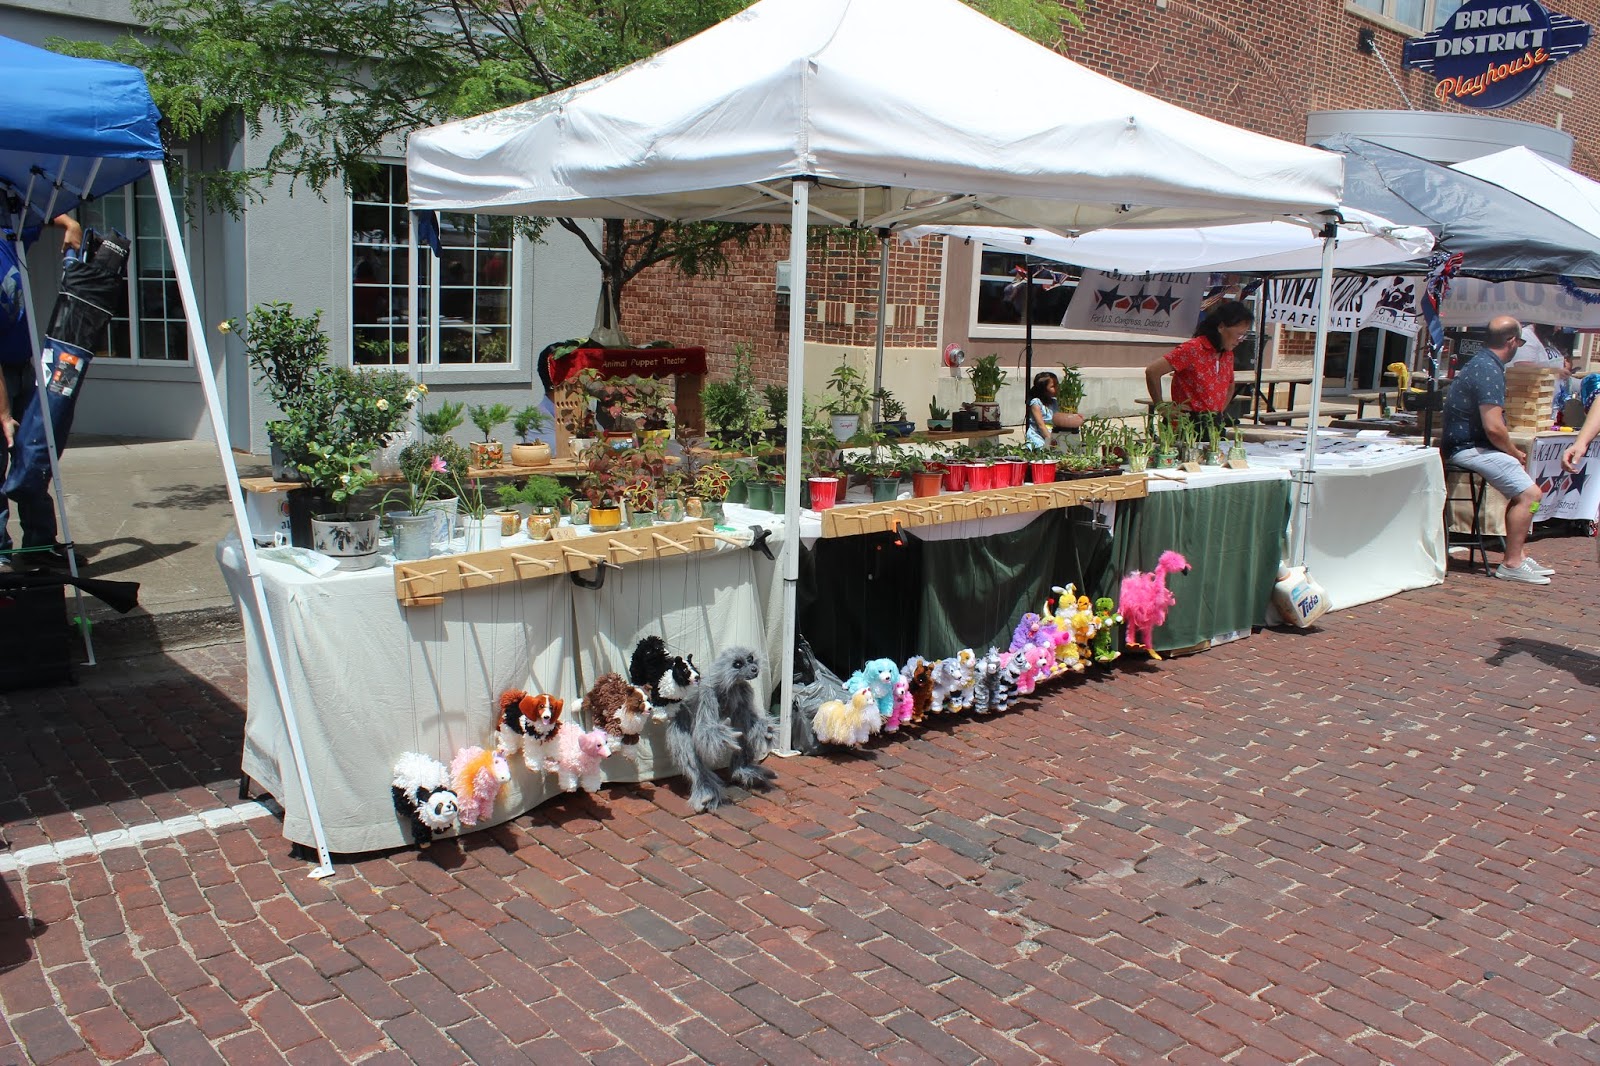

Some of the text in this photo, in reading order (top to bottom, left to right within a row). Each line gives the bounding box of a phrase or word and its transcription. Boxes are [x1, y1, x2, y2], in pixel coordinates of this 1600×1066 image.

[1455, 3, 1532, 30] BRICK
[1435, 28, 1548, 57] DISTRICT
[1434, 47, 1550, 104] Playhouse
[1090, 314, 1101, 322] For
[1144, 318, 1165, 328] District
[1165, 320, 1170, 328] 3
[1271, 309, 1317, 326] STATE
[1330, 317, 1361, 328] NATE
[602, 356, 687, 368] Animal Puppet Theater
[1537, 442, 1566, 462] KATY
[1298, 594, 1319, 618] Tide
